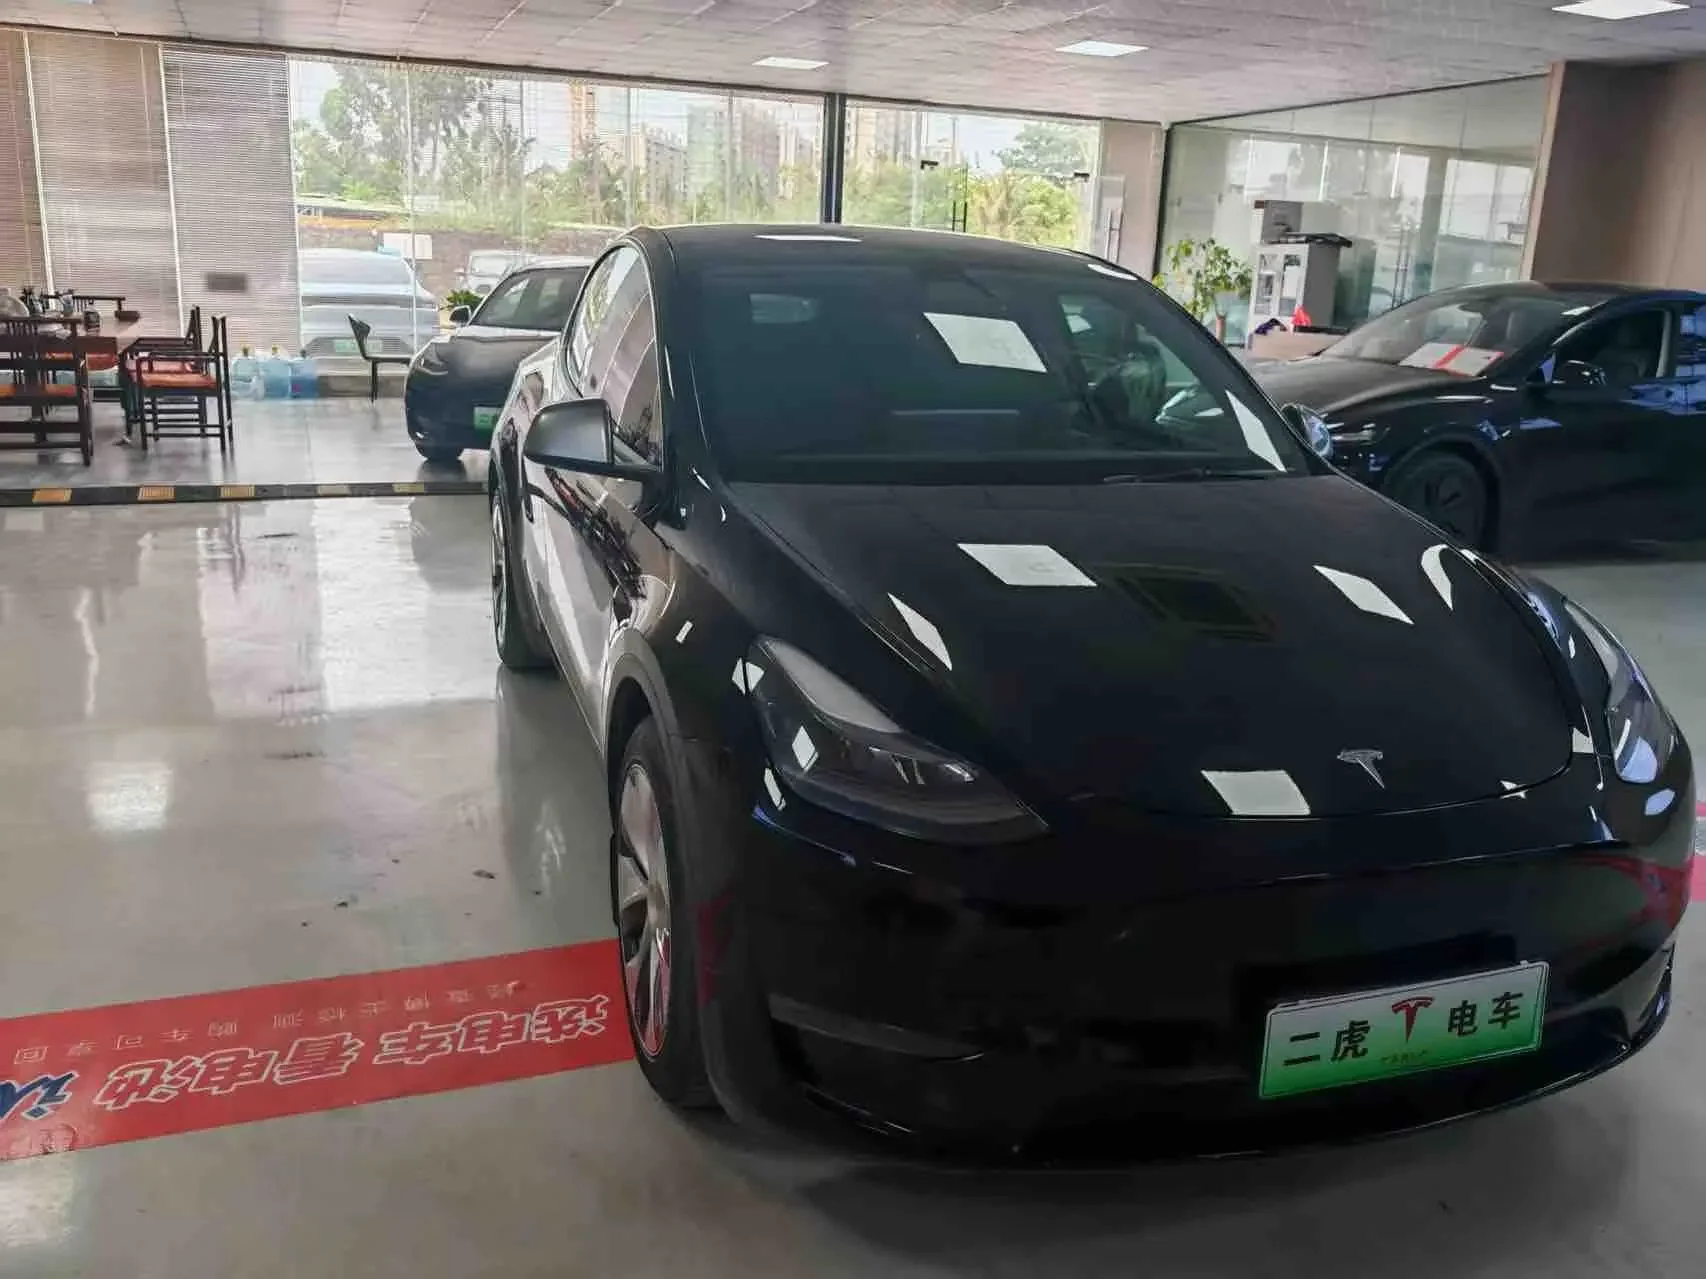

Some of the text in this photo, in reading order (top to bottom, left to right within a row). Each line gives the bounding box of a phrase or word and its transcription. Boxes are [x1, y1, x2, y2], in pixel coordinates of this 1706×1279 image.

[372, 994, 610, 1067] 选电车
[1283, 1019, 1371, 1067] 二虎
[1447, 991, 1524, 1037] 电车
[94, 1030, 365, 1111] 看电池
